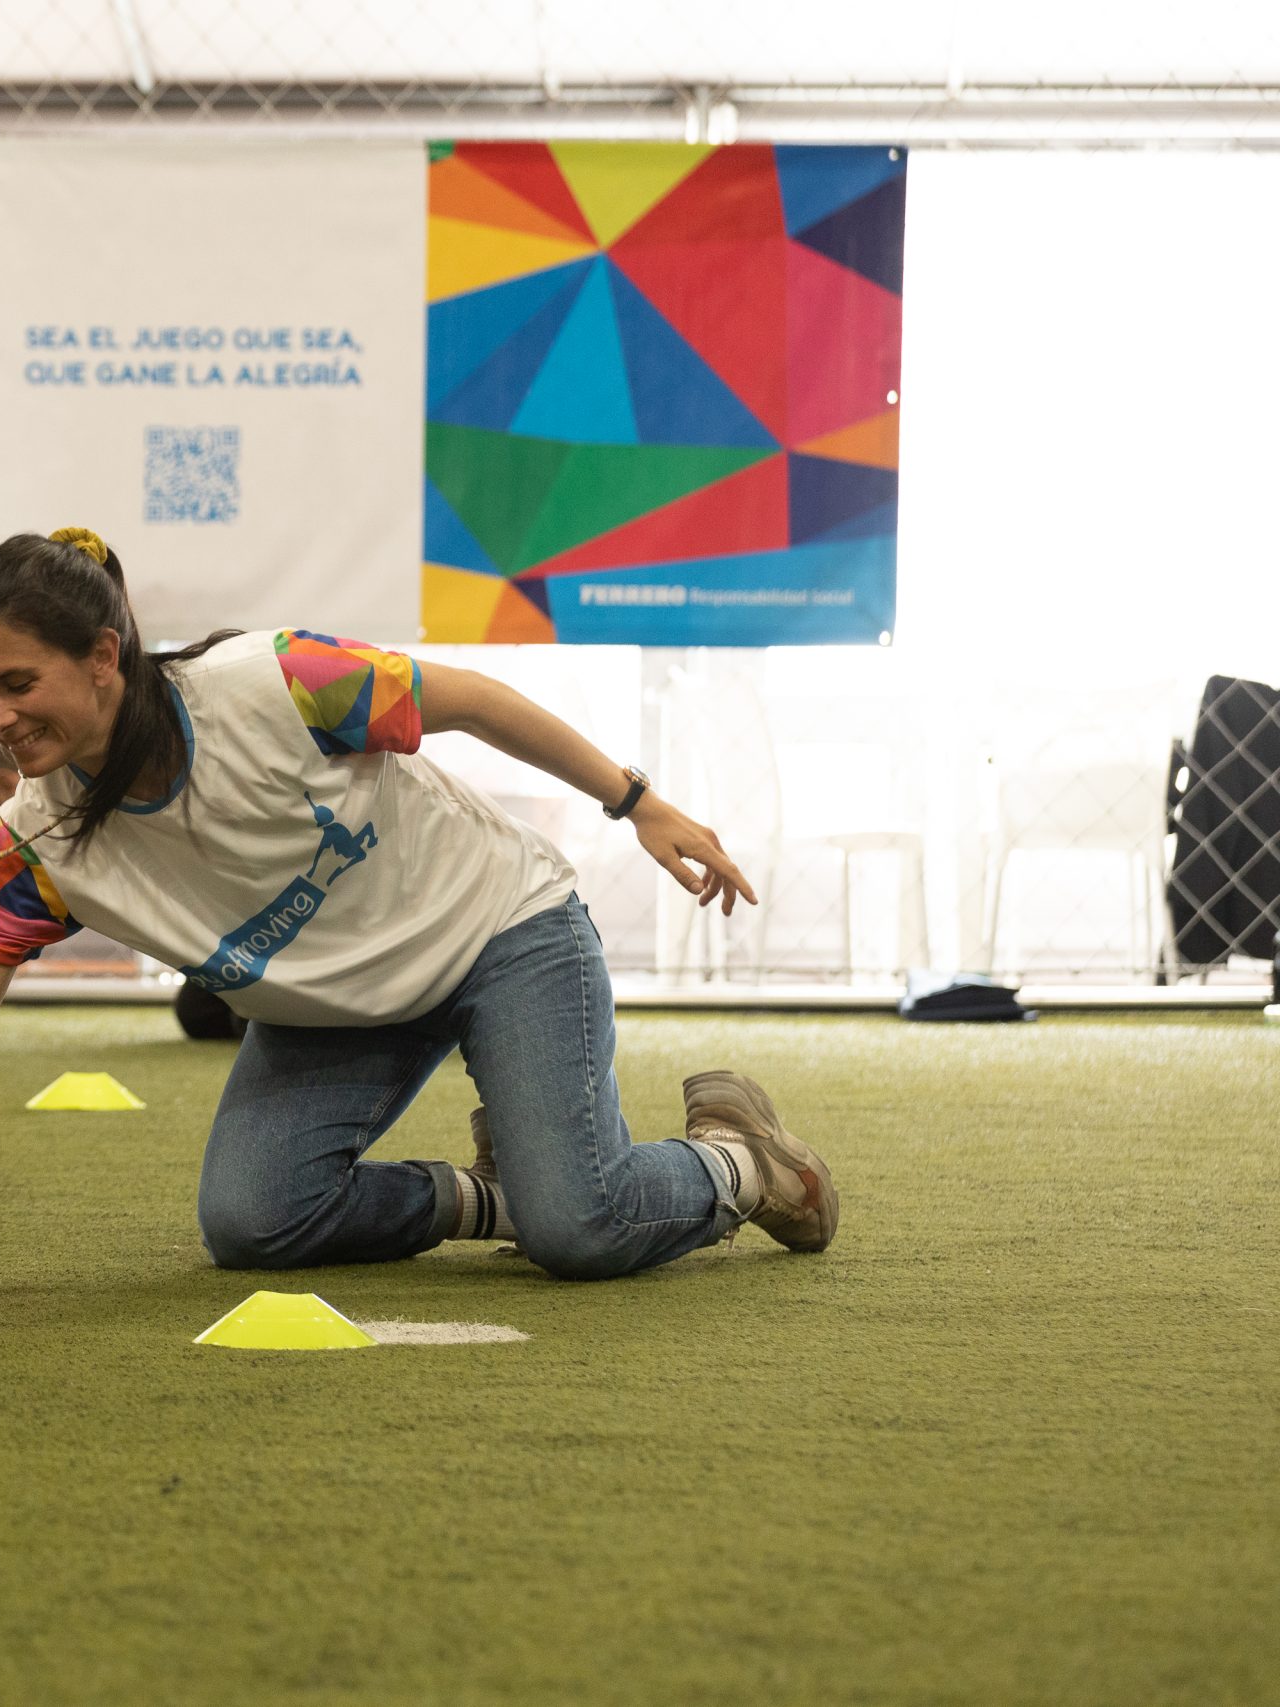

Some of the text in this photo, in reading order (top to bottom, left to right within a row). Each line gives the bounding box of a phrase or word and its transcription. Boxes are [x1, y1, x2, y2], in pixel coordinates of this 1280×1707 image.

[26, 327, 363, 353] SEA EL JUEGO QUE SEA,
[25, 355, 362, 387] QUE GANE LA ALEGRÍA
